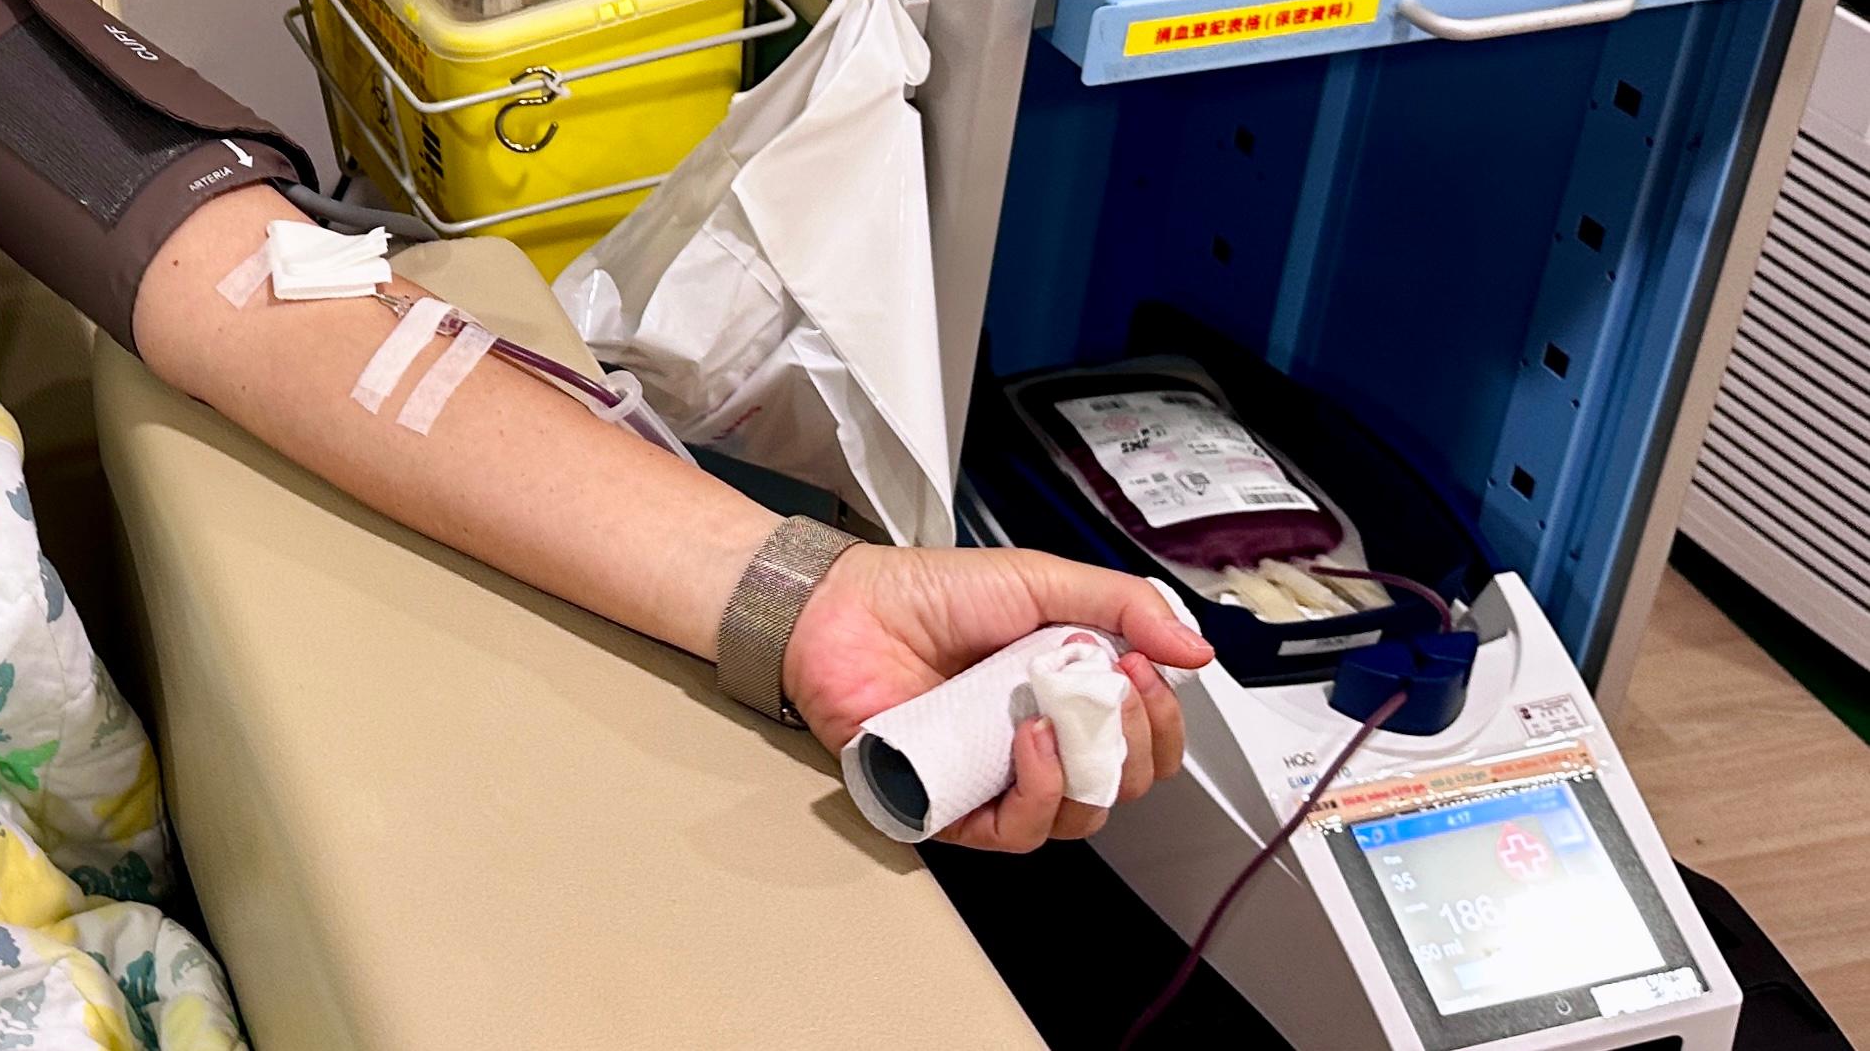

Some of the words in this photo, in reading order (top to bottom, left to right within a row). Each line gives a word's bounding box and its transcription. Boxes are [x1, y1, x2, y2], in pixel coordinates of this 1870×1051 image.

[103, 23, 159, 61] CUFF
[189, 166, 234, 192] ARTERIA
[1282, 752, 1316, 768] HQC
[1390, 872, 1417, 893] 35
[1439, 895, 1499, 936] 186
